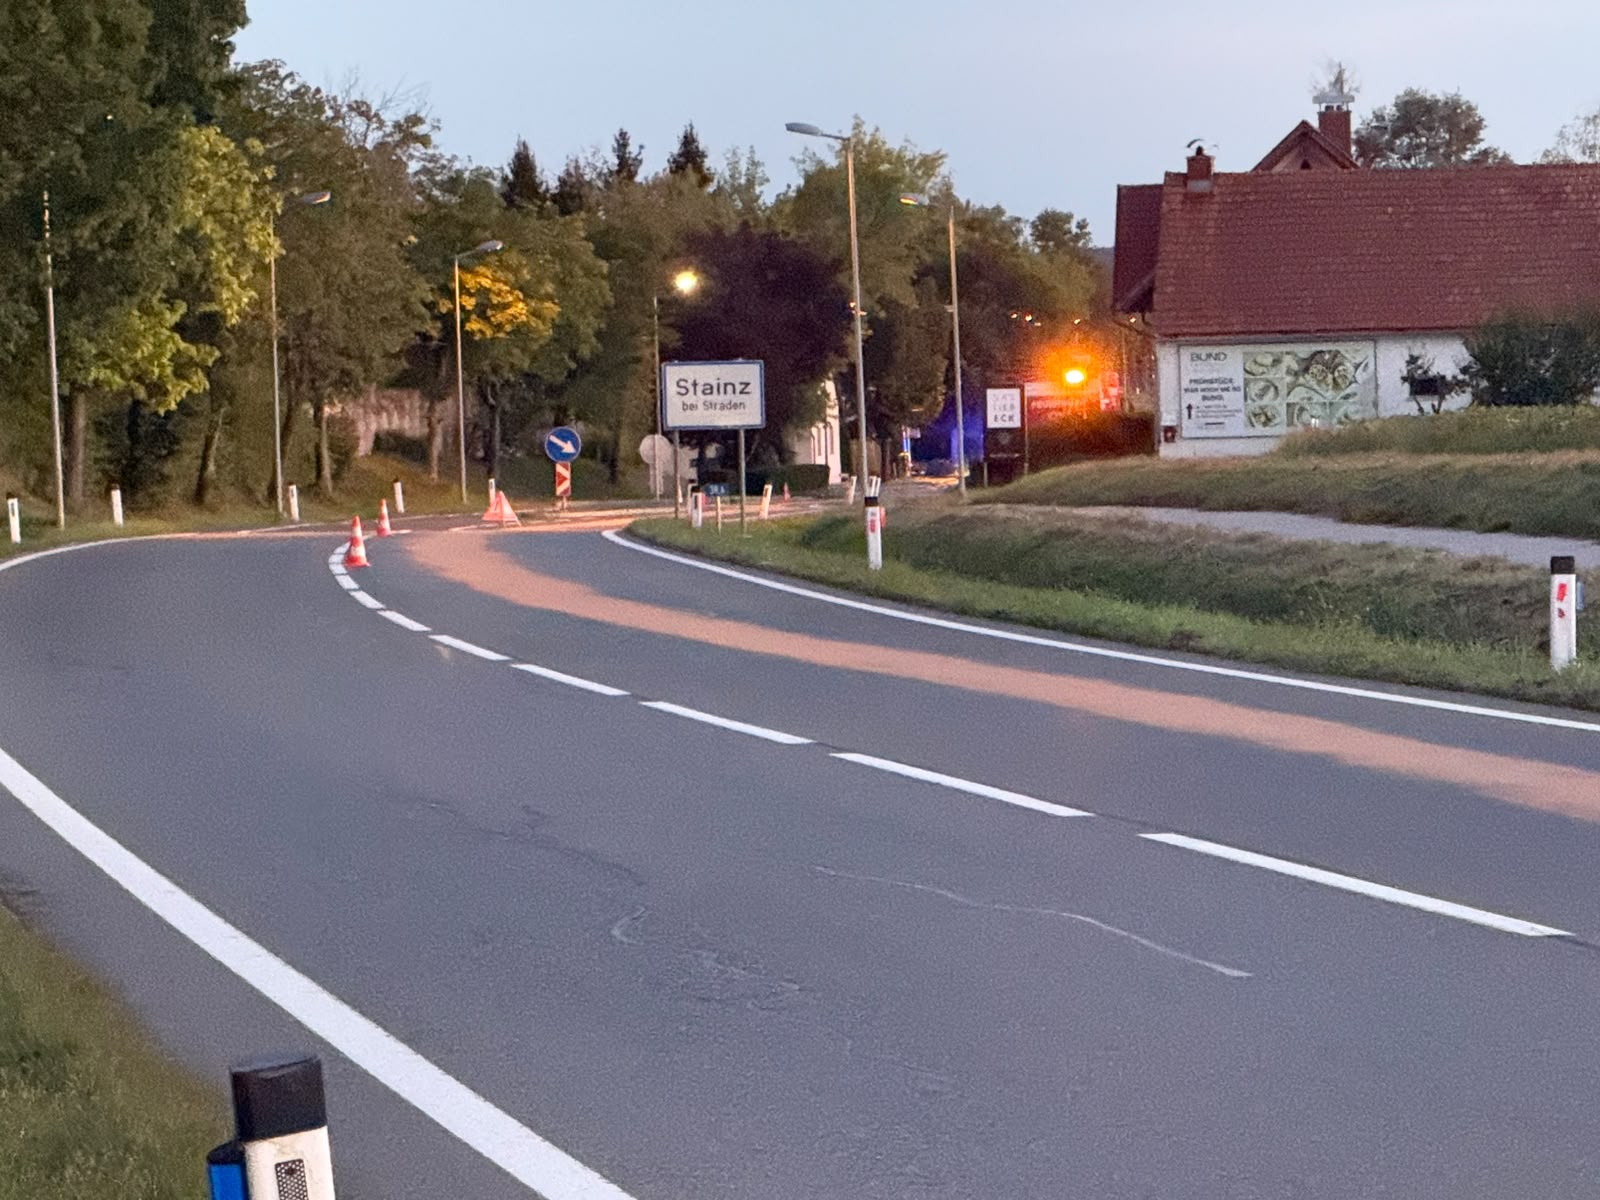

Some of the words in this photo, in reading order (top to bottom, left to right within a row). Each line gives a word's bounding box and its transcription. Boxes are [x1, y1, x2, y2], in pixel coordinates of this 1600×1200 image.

[1191, 352, 1227, 361] BUND
[676, 378, 752, 396] Stainz
[681, 401, 698, 411] bei
[703, 400, 746, 411] Straden
